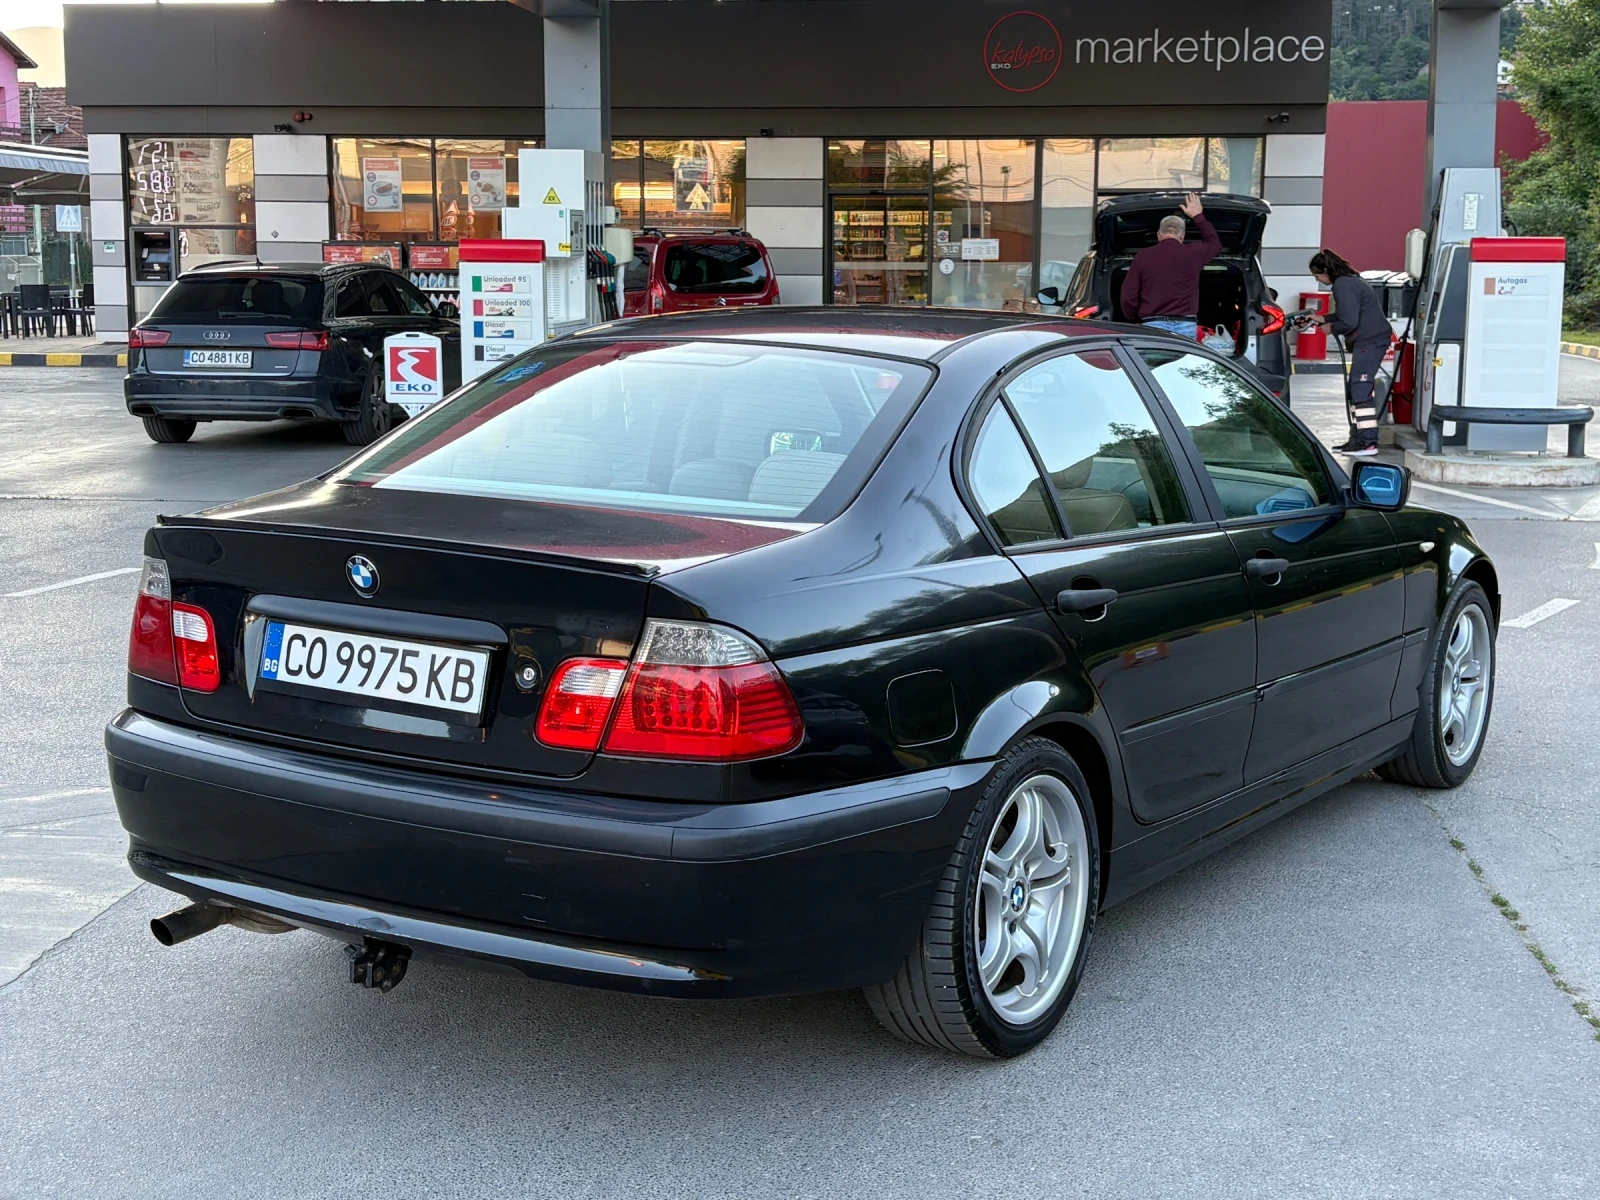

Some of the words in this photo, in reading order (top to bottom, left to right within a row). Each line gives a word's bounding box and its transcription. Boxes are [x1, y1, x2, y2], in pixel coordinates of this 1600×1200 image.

[991, 40, 1055, 68] kalypso
[1075, 27, 1325, 71] marketplace
[1498, 277, 1528, 285] Autogas
[191, 352, 205, 363] CO
[207, 352, 232, 364] 4881
[235, 352, 249, 364] KB
[395, 383, 432, 392] EKO
[264, 657, 278, 673] BG
[285, 633, 327, 680] CO
[336, 641, 421, 694] 9975
[425, 653, 476, 704] KB
